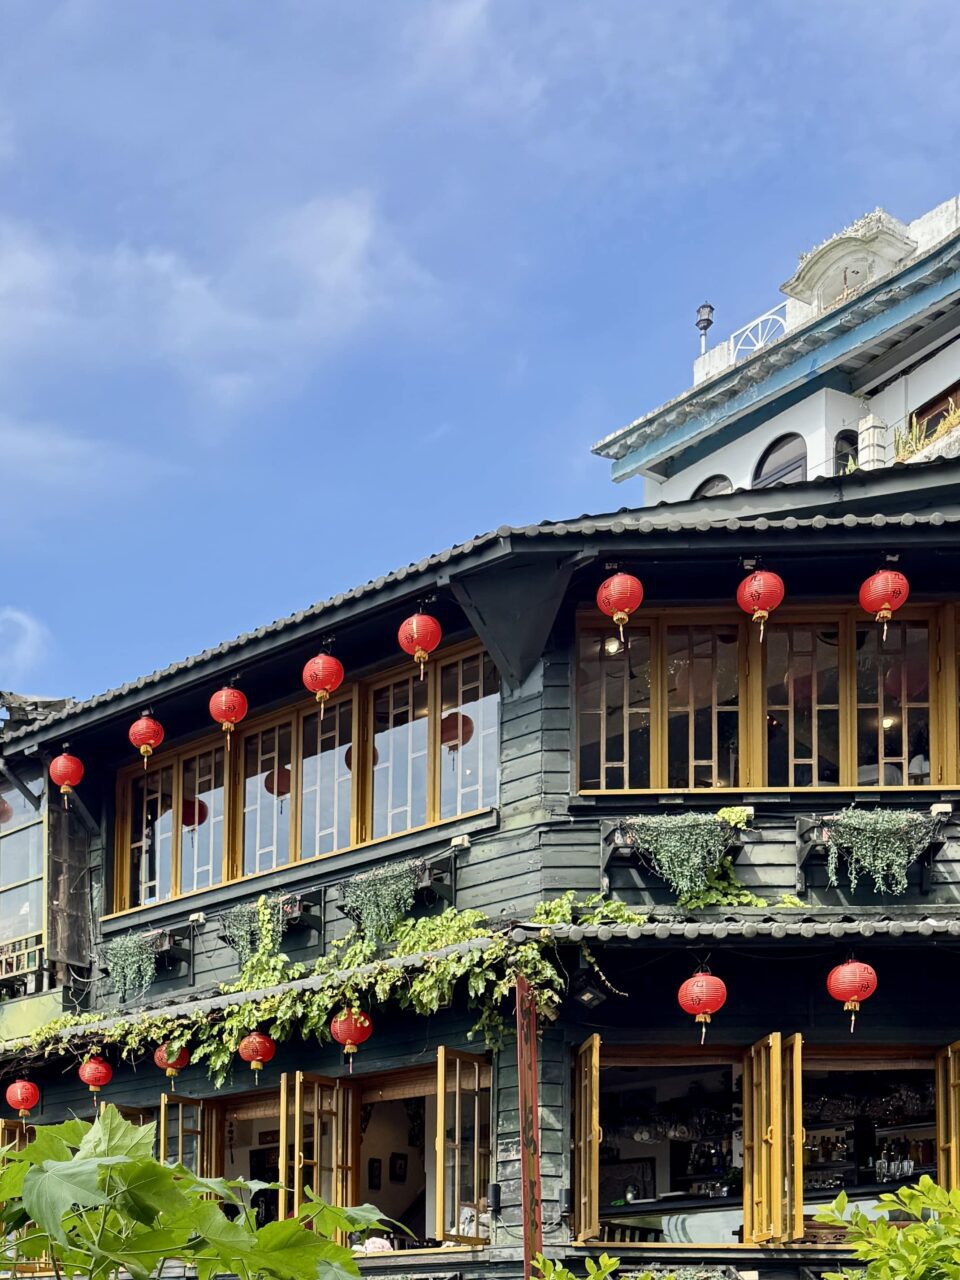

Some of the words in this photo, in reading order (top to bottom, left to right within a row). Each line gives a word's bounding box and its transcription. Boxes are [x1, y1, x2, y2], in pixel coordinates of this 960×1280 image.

[750, 575, 761, 601] 九份
[892, 573, 904, 599] 九份
[859, 966, 872, 992] 九份
[691, 980, 704, 1005] 九份
